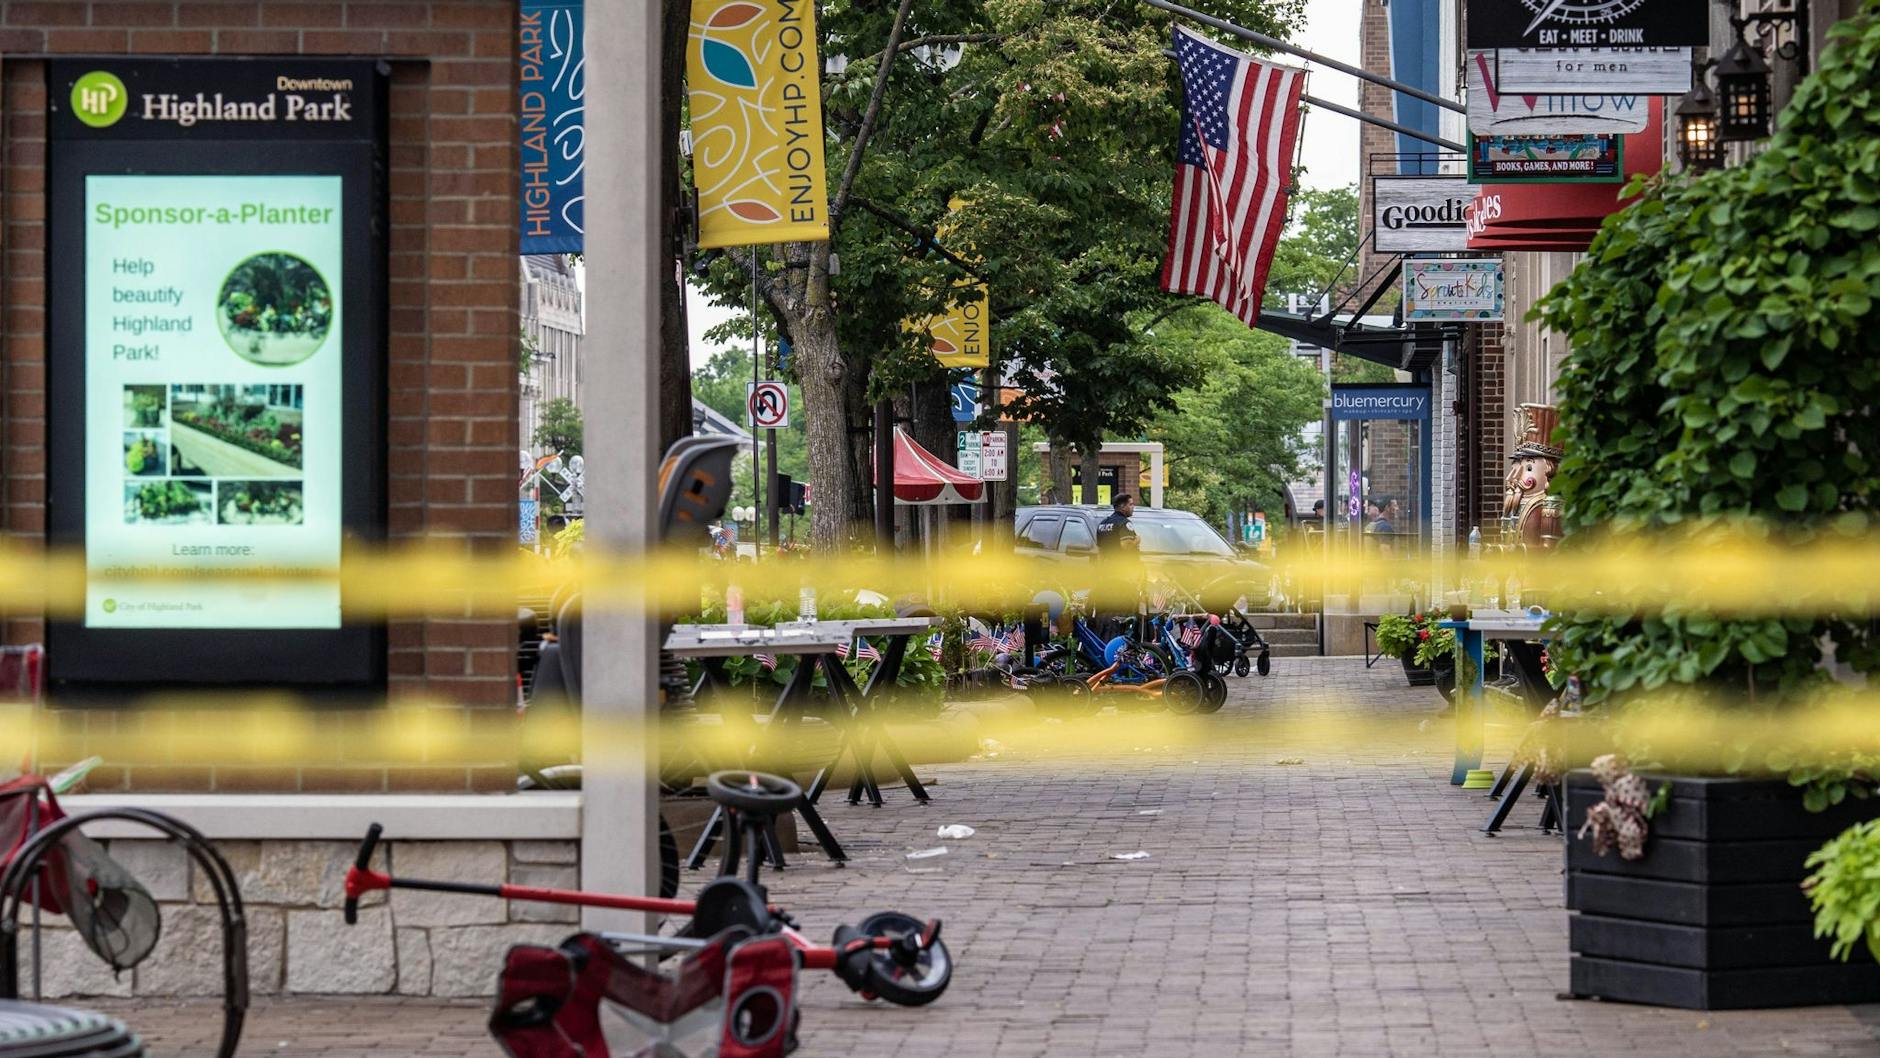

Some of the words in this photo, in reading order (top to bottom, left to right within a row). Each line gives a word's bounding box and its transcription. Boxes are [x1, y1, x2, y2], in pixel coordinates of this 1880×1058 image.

[1539, 29, 1559, 44] EAT
[1570, 29, 1598, 44] MEET
[1609, 28, 1644, 43] DRINK
[520, 11, 545, 81] PARK
[1556, 61, 1584, 72] for
[1593, 63, 1628, 72] men
[277, 76, 353, 91] Downtown
[142, 93, 277, 126] Highland
[285, 94, 352, 121] Park
[778, 0, 814, 223] ENJOYHP.COM
[521, 92, 551, 236] HIGHLAND
[1496, 162, 1523, 172] BOOKS,
[1524, 162, 1551, 172] GAMES,
[1552, 161, 1568, 170] AND
[95, 203, 333, 229] Sponsor-a-Planter
[112, 258, 155, 277] Help
[112, 287, 184, 306] beautify
[112, 315, 193, 336] Highland
[112, 344, 159, 361] Park!
[1333, 392, 1425, 411] bluemercury
[959, 435, 966, 447] 2
[172, 544, 212, 556] Learn
[215, 545, 255, 556] more:
